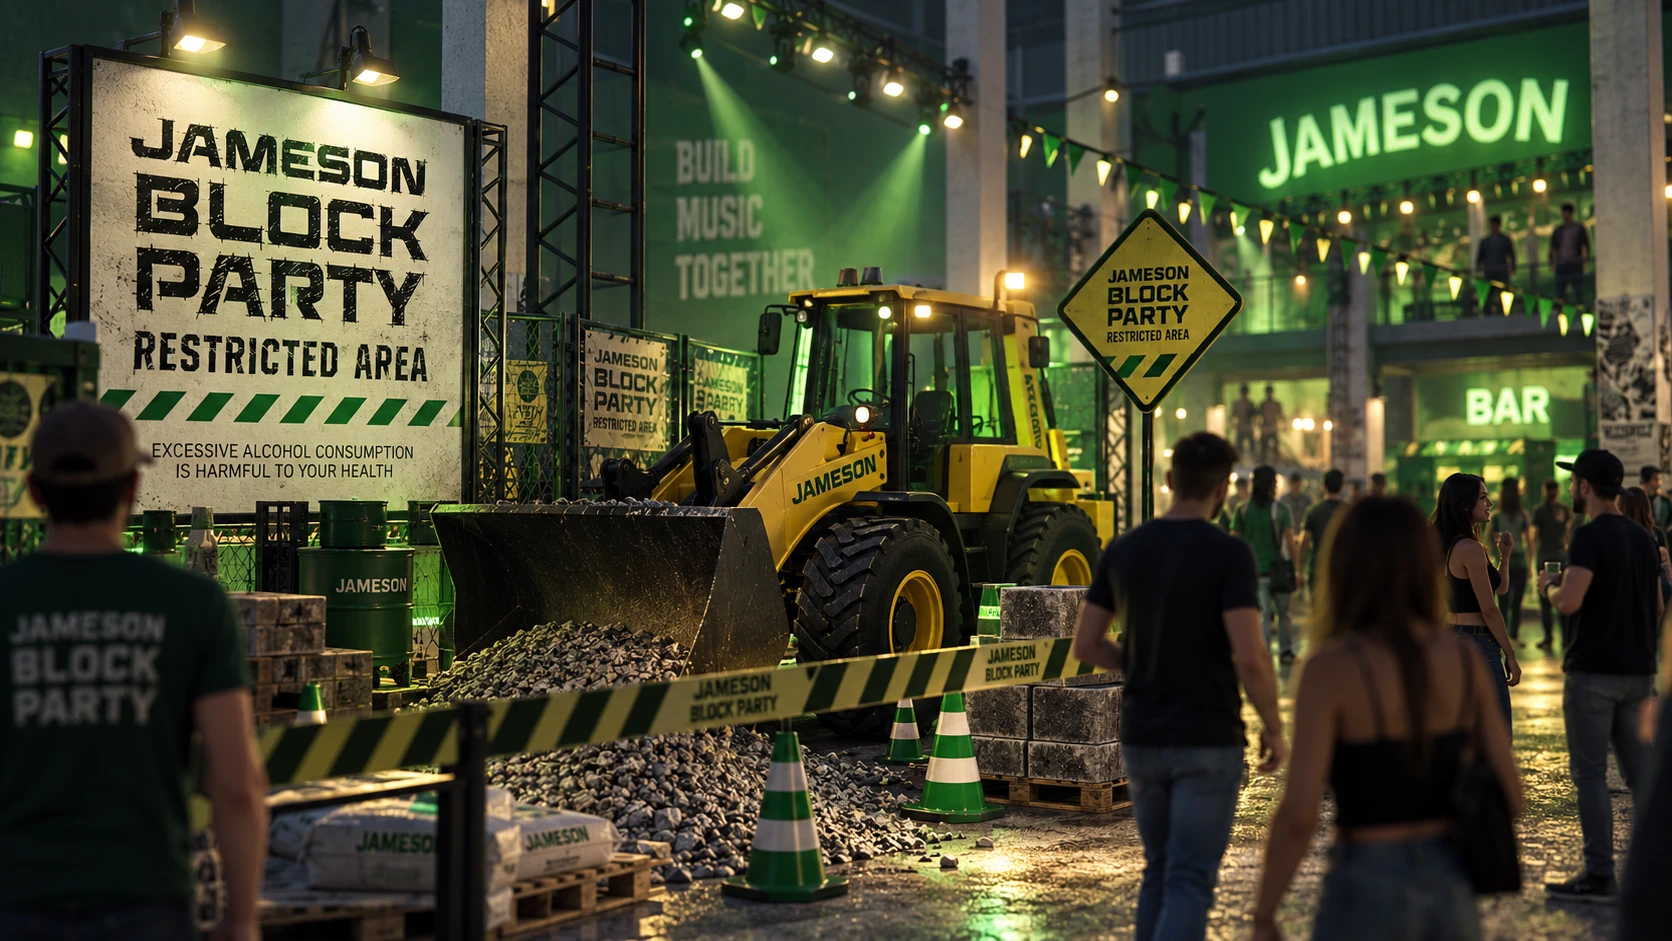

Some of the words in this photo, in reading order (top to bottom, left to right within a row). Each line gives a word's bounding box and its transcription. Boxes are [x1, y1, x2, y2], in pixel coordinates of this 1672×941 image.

[1258, 78, 1569, 188] JAMESON
[130, 118, 427, 196] JAMESON
[675, 139, 755, 184] BUILD
[135, 171, 428, 262] BLOCK
[676, 194, 763, 241] MUSIC
[135, 245, 427, 327] PARTY
[675, 248, 814, 300] TOGETHER
[1108, 265, 1189, 283] JAMESON
[1108, 284, 1189, 305] BLOCK
[1108, 305, 1189, 326] PARTY
[1107, 330, 1162, 344] RESTRICTED
[1165, 329, 1190, 341] AREA
[133, 330, 338, 378] RESTRICTED
[354, 343, 428, 382] AREA
[594, 349, 658, 371] JAMESON
[594, 367, 657, 394] BLOCK
[594, 391, 657, 416] PARTY
[1466, 386, 1550, 426] BAR
[593, 417, 637, 432] RESTRICTED
[639, 421, 657, 434] AREA
[152, 443, 238, 459] EXCESSIVE
[243, 444, 311, 459] ALCOHOL
[316, 445, 414, 459] CONSUMPTION
[176, 463, 190, 478] IS
[195, 463, 270, 478] HARMFUL
[275, 464, 294, 478] TO
[298, 464, 336, 478] YOUR
[341, 464, 393, 478] HEALTH
[792, 454, 876, 505] JAMESON
[336, 577, 407, 594] JAMESON
[9, 610, 165, 643] JAMESON
[12, 644, 160, 685] BLOCK
[988, 645, 1036, 664] JAMESON
[985, 665, 1013, 682] BLOCK
[1014, 662, 1040, 678] PARTY
[693, 673, 772, 700] JAMESON
[14, 686, 157, 727] PARTY
[690, 701, 733, 722] BLOCK
[737, 695, 778, 716] PARTY
[355, 830, 438, 855] JAMESO
[526, 825, 590, 852] JAMESON
